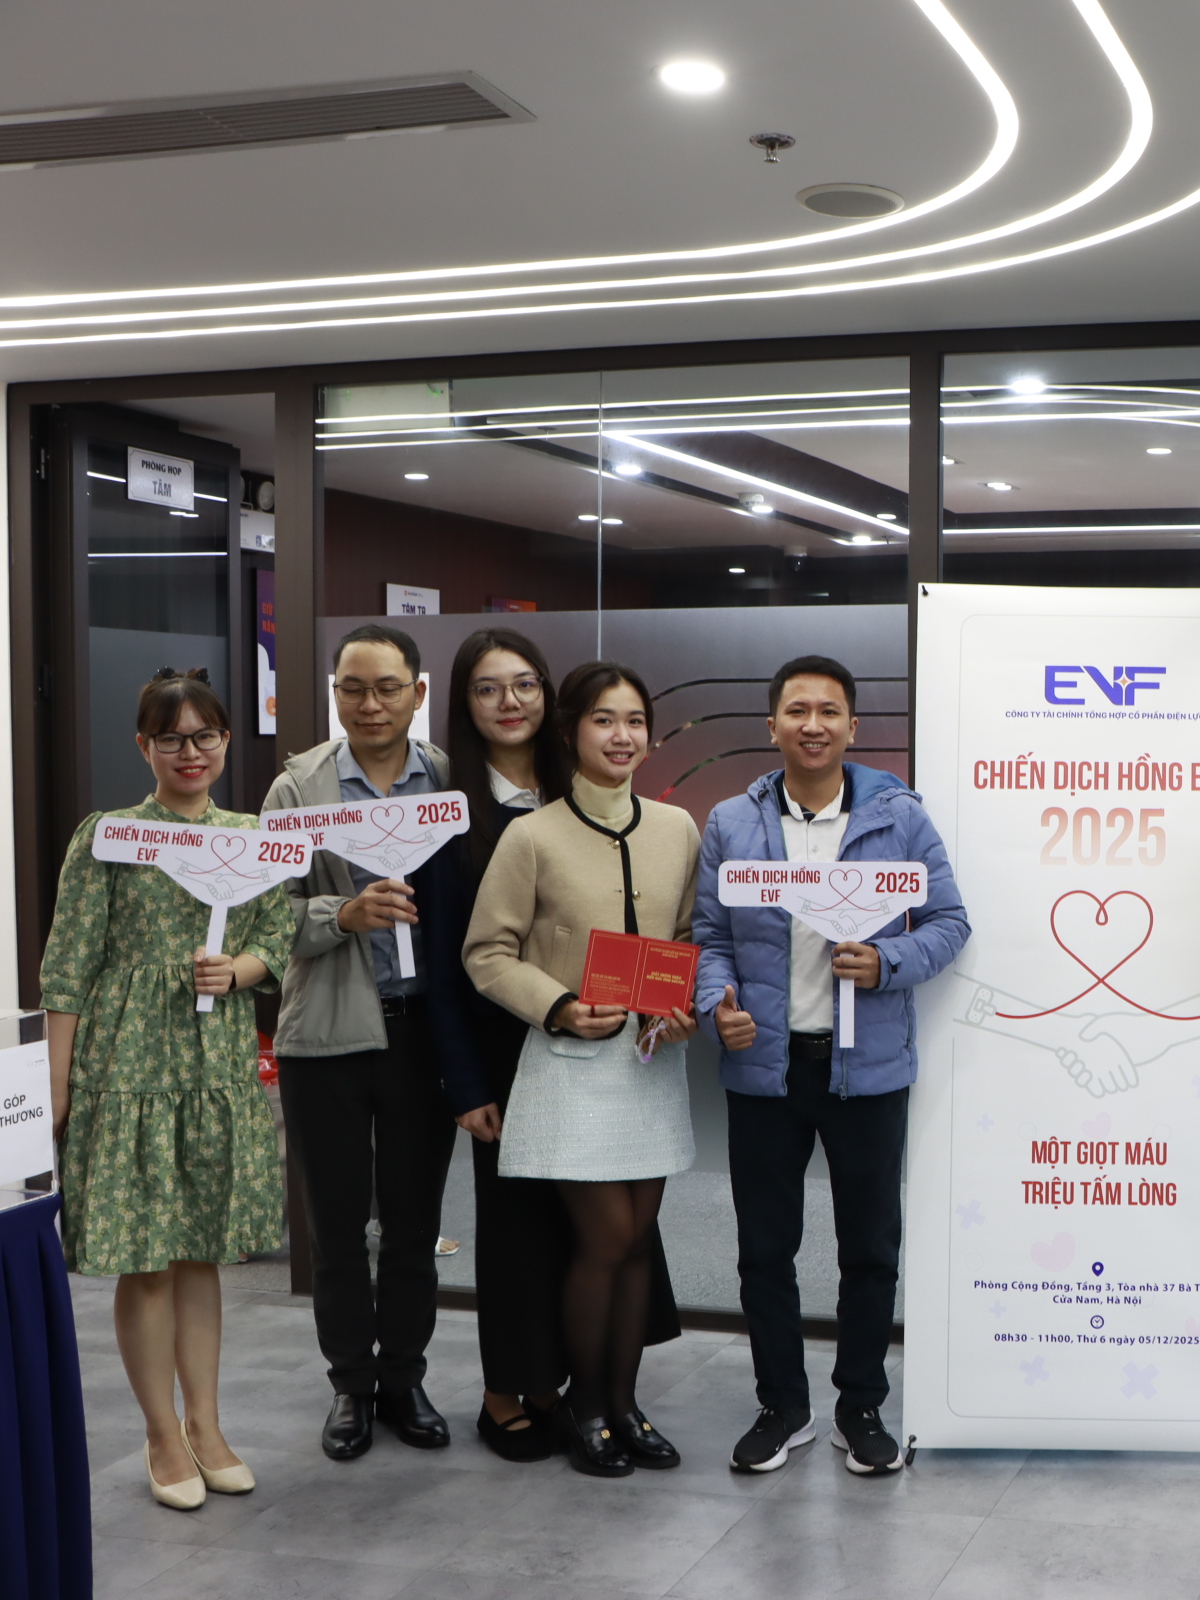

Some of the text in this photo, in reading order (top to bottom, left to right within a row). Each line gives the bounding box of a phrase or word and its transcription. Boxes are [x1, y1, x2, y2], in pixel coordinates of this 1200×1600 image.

[141, 459, 182, 477] PHÒNG HỌP
[152, 479, 172, 497] TÂM
[1044, 665, 1166, 706] EVF
[1005, 709, 1029, 719] CÔNG
[1042, 709, 1055, 719] TÀI
[1056, 709, 1084, 719] CHÍNH
[1109, 710, 1127, 721] HỢP
[1167, 710, 1187, 721] ĐIỆN
[973, 751, 1046, 790] CHIẾN
[1053, 761, 1110, 796] DỊCH
[1117, 753, 1183, 791] HỒNG
[267, 806, 363, 832] CHIẾN DỊCH HỒNG
[416, 800, 462, 826] 2025
[104, 824, 204, 848] CHIẾN DỊCH HỒNG
[307, 832, 325, 846] VF
[1039, 806, 1166, 867] 2025
[136, 847, 160, 862] EVF
[257, 840, 306, 865] 2025
[726, 866, 821, 887] CHIẾN DỊCH HỒNG
[875, 872, 920, 894] 2025
[760, 889, 782, 903] EVF
[3, 1093, 26, 1110] GÓP
[0, 1106, 44, 1128] THƯƠNG
[1031, 1136, 1168, 1170] MỘT GIỌT MÁU
[1021, 1175, 1177, 1210] TRIỆU TẤM LÒNG
[974, 1280, 1008, 1292] Phòng
[1011, 1281, 1039, 1293] Cộng
[1041, 1280, 1074, 1293] Đồng,
[1076, 1281, 1102, 1294] Tầng
[1105, 1283, 1115, 1293] 3,
[1117, 1283, 1137, 1293] Tòa
[1139, 1283, 1159, 1293] nhà
[1162, 1283, 1175, 1292] 37
[1178, 1283, 1192, 1293] Bà
[1053, 1293, 1142, 1307] Cửa Nam, Hà Nội
[994, 1333, 1028, 1343] 08h30
[1038, 1334, 1074, 1345] 11h00,
[1077, 1334, 1097, 1344] Thứ
[1100, 1335, 1106, 1344] 6
[1109, 1335, 1136, 1347] ngày
[1138, 1335, 1200, 1346] 05/12/2025
